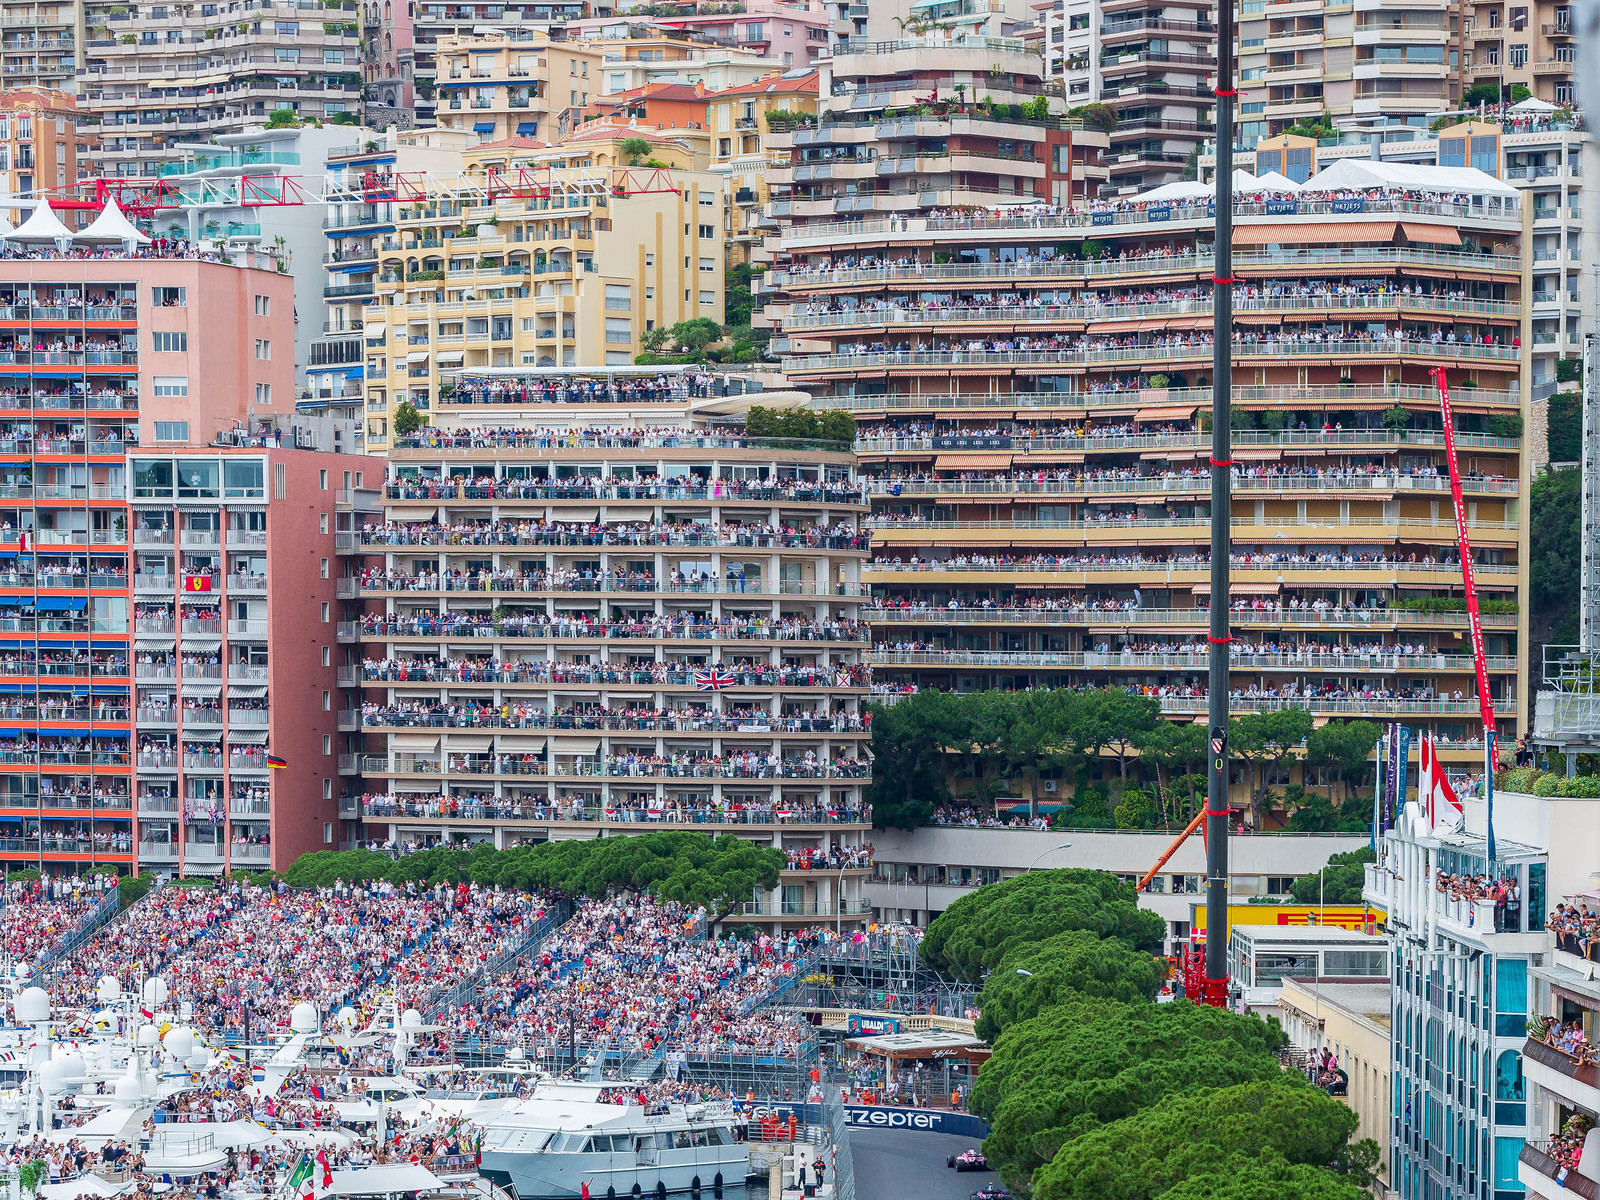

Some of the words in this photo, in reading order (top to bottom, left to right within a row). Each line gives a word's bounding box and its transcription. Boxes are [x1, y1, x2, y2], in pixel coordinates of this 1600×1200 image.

[1268, 203, 1294, 213] NETJETS
[1334, 202, 1361, 212] NETJETS
[861, 1019, 884, 1030] UBALDI
[857, 1110, 942, 1128] zepter
